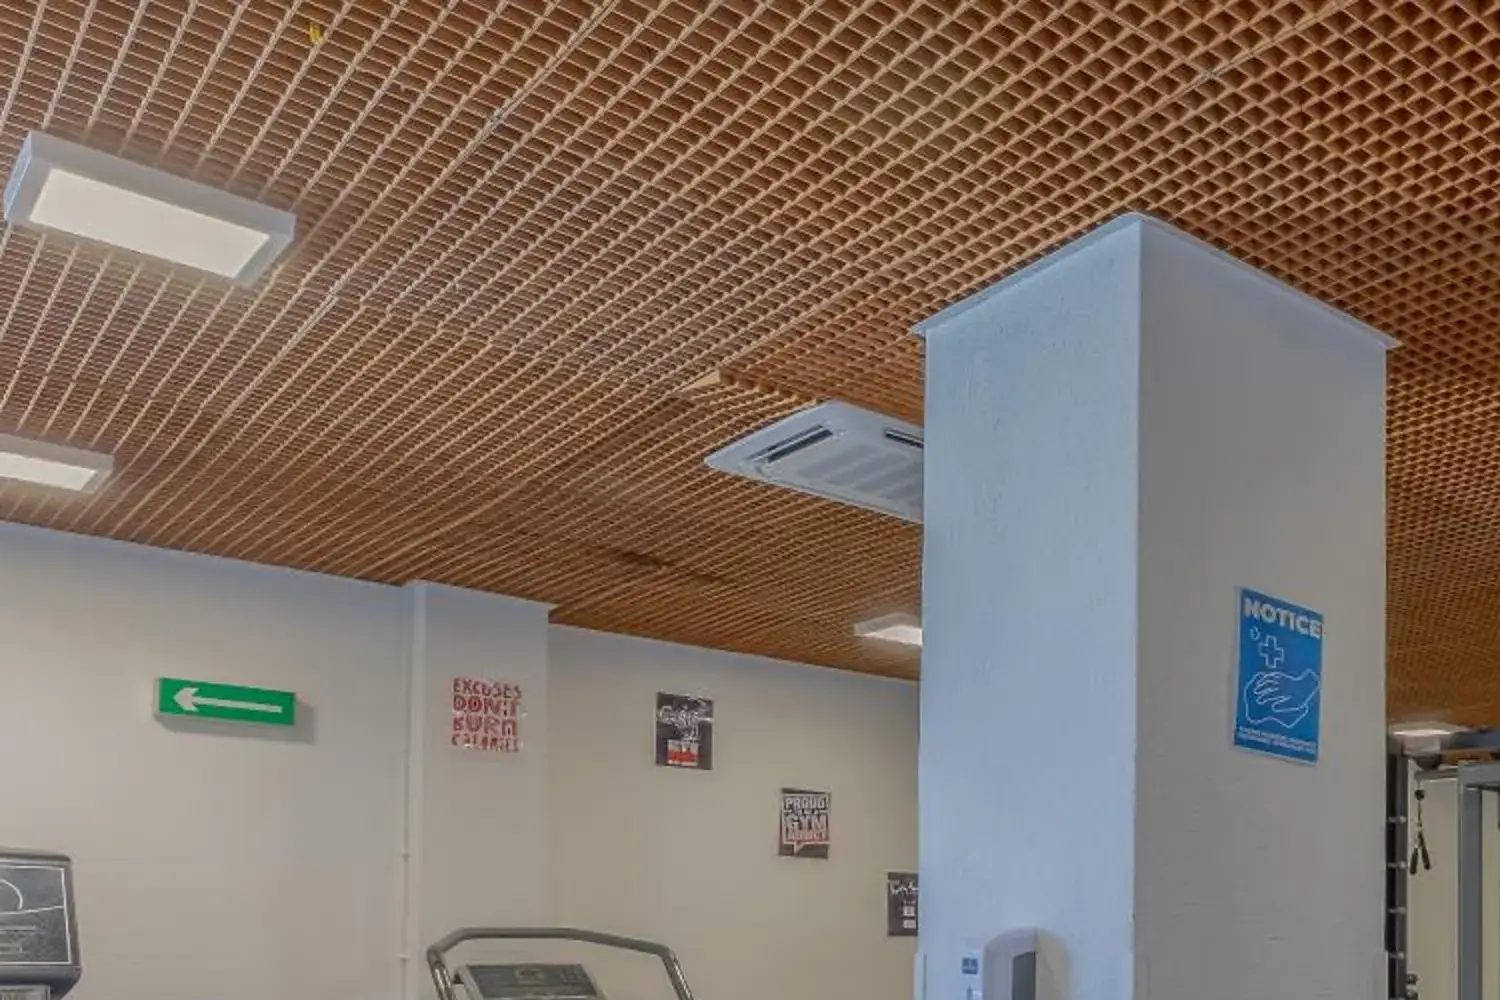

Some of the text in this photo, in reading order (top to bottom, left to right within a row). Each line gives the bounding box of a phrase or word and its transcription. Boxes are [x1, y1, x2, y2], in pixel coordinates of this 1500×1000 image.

[1244, 597, 1323, 639] NOTICE
[453, 678, 522, 699] EXCUSES
[784, 796, 826, 810] PROUD
[784, 813, 827, 831] GYM
